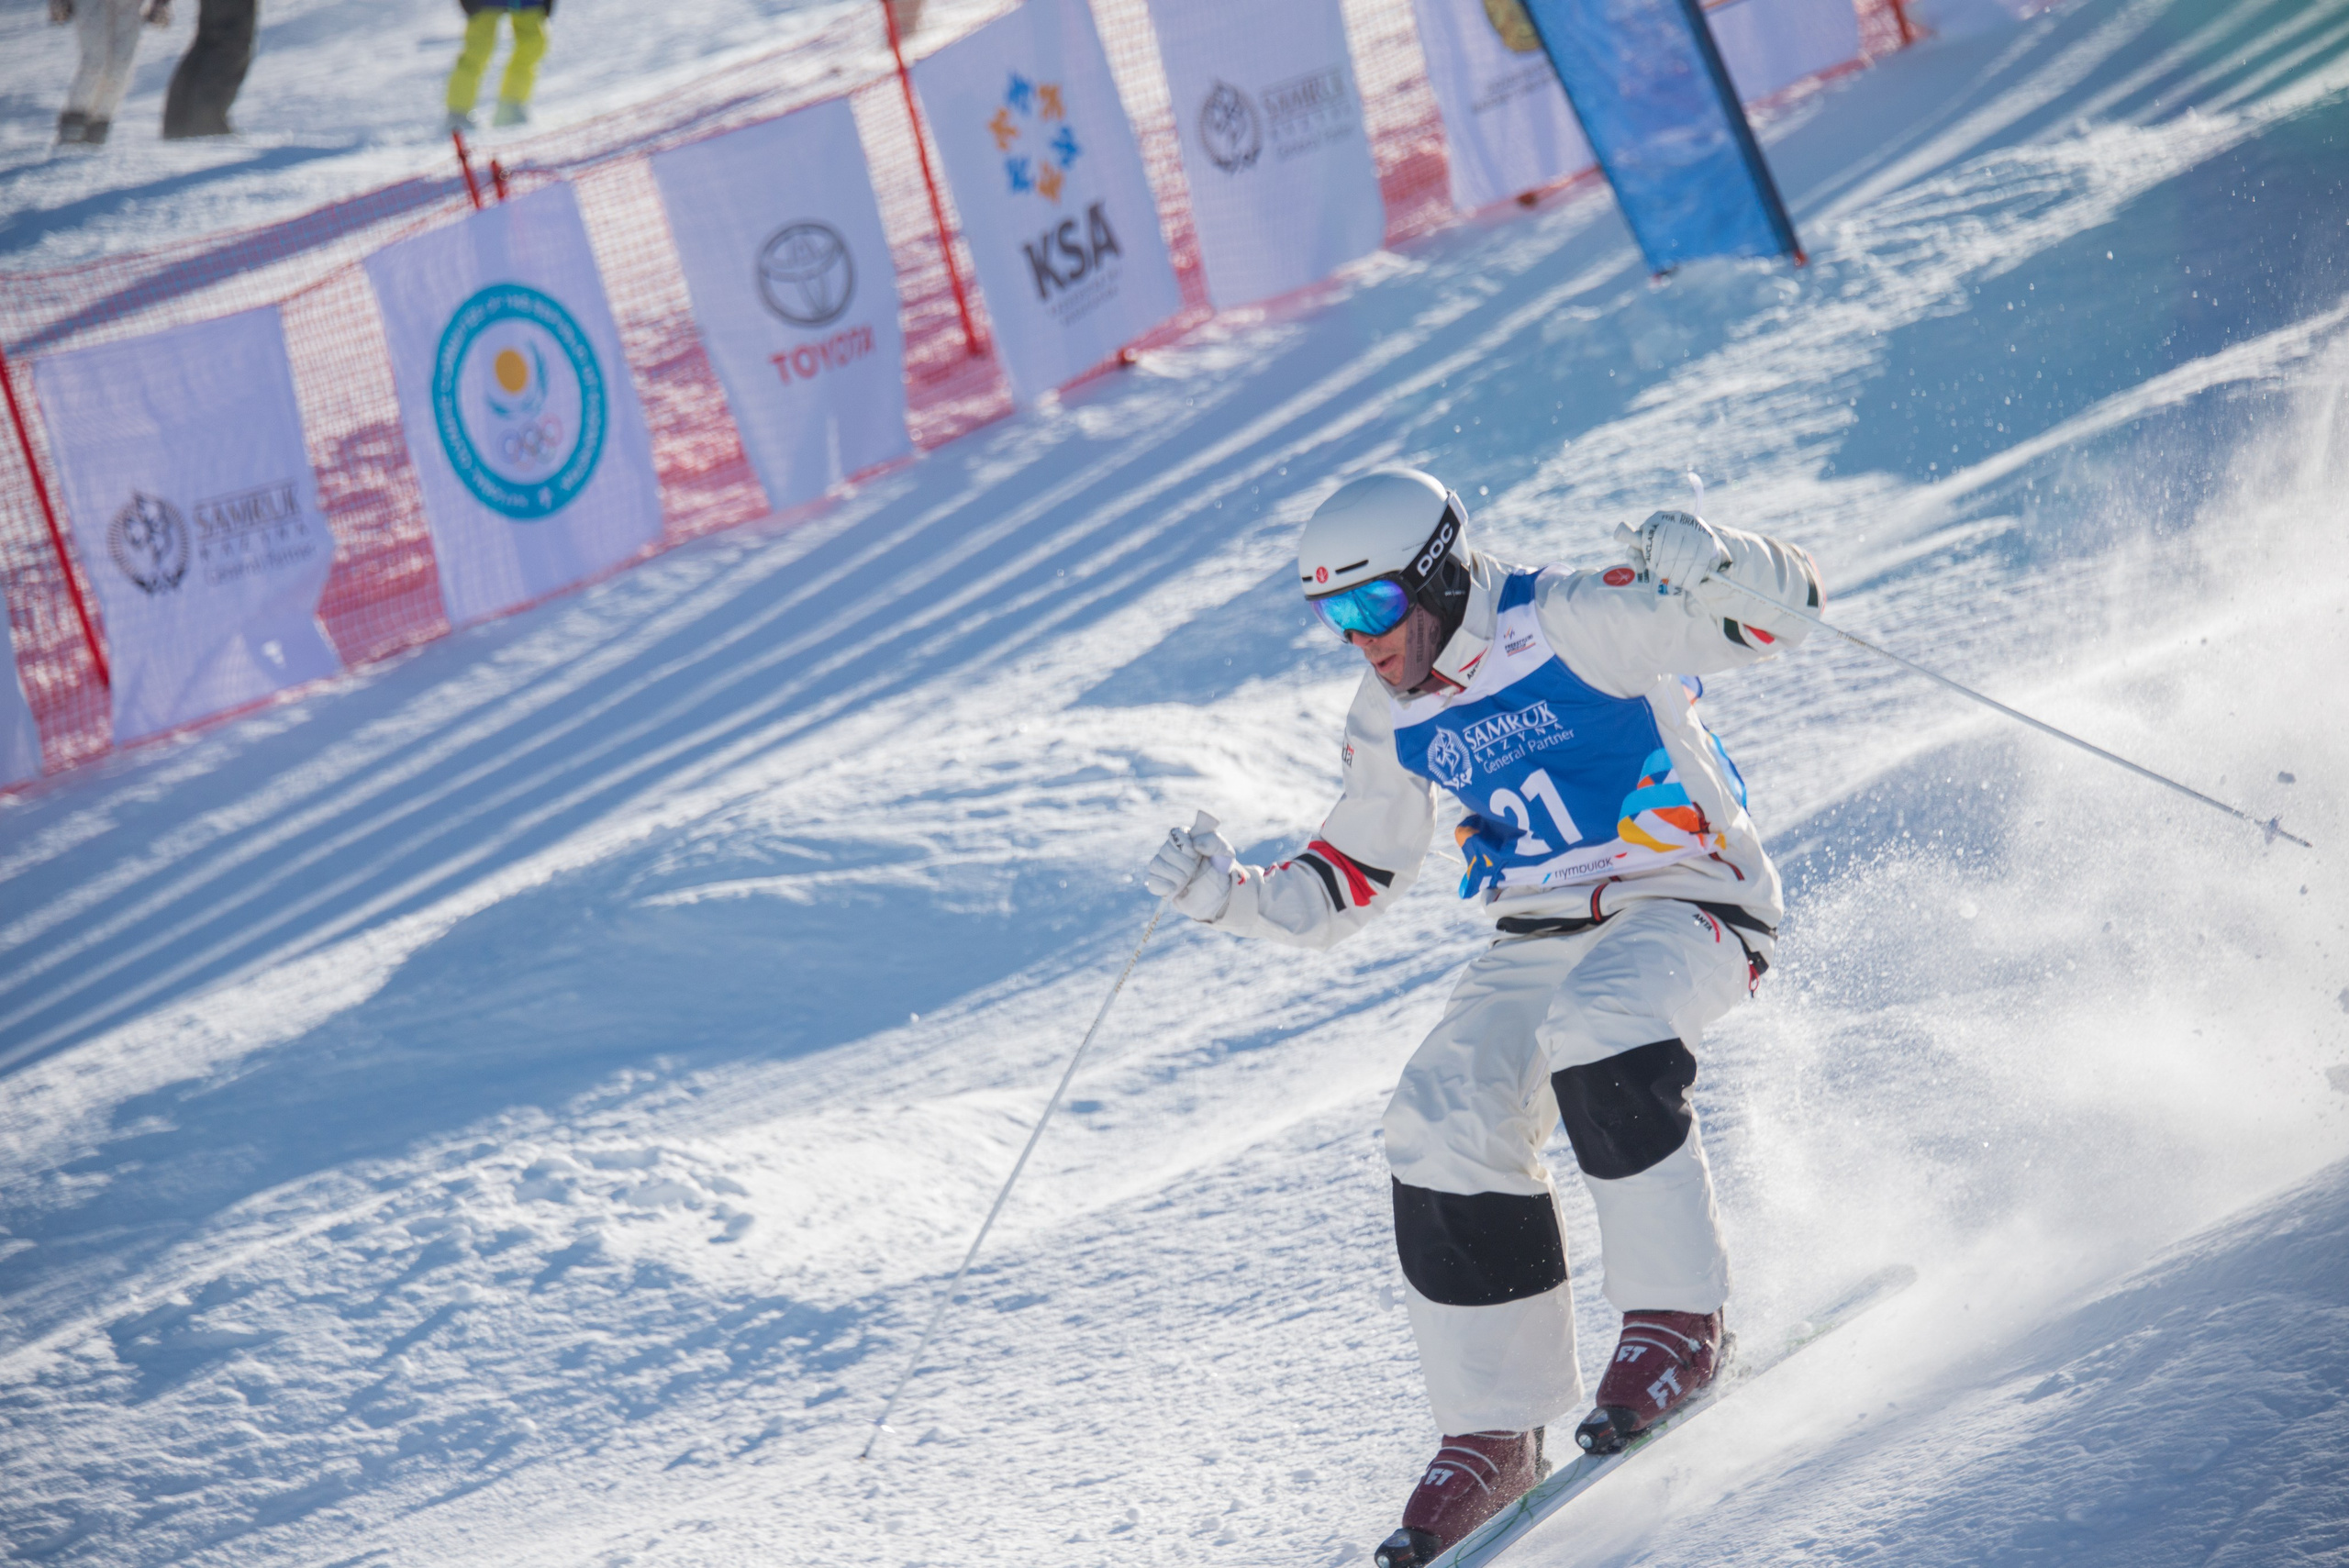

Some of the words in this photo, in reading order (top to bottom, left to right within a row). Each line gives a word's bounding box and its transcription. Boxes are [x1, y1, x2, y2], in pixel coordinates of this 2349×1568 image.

[1023, 203, 1120, 299] KSA
[770, 325, 875, 384] TOYOTA
[1464, 703, 1556, 751] SAMRUK
[1475, 722, 1563, 763] KAZYNA
[1483, 743, 1526, 773] General
[1528, 728, 1575, 752] Partner
[1489, 768, 1583, 856] 21
[1616, 1345, 1648, 1362] FT
[1646, 1364, 1682, 1409] FT
[1424, 1468, 1454, 1485] FT
